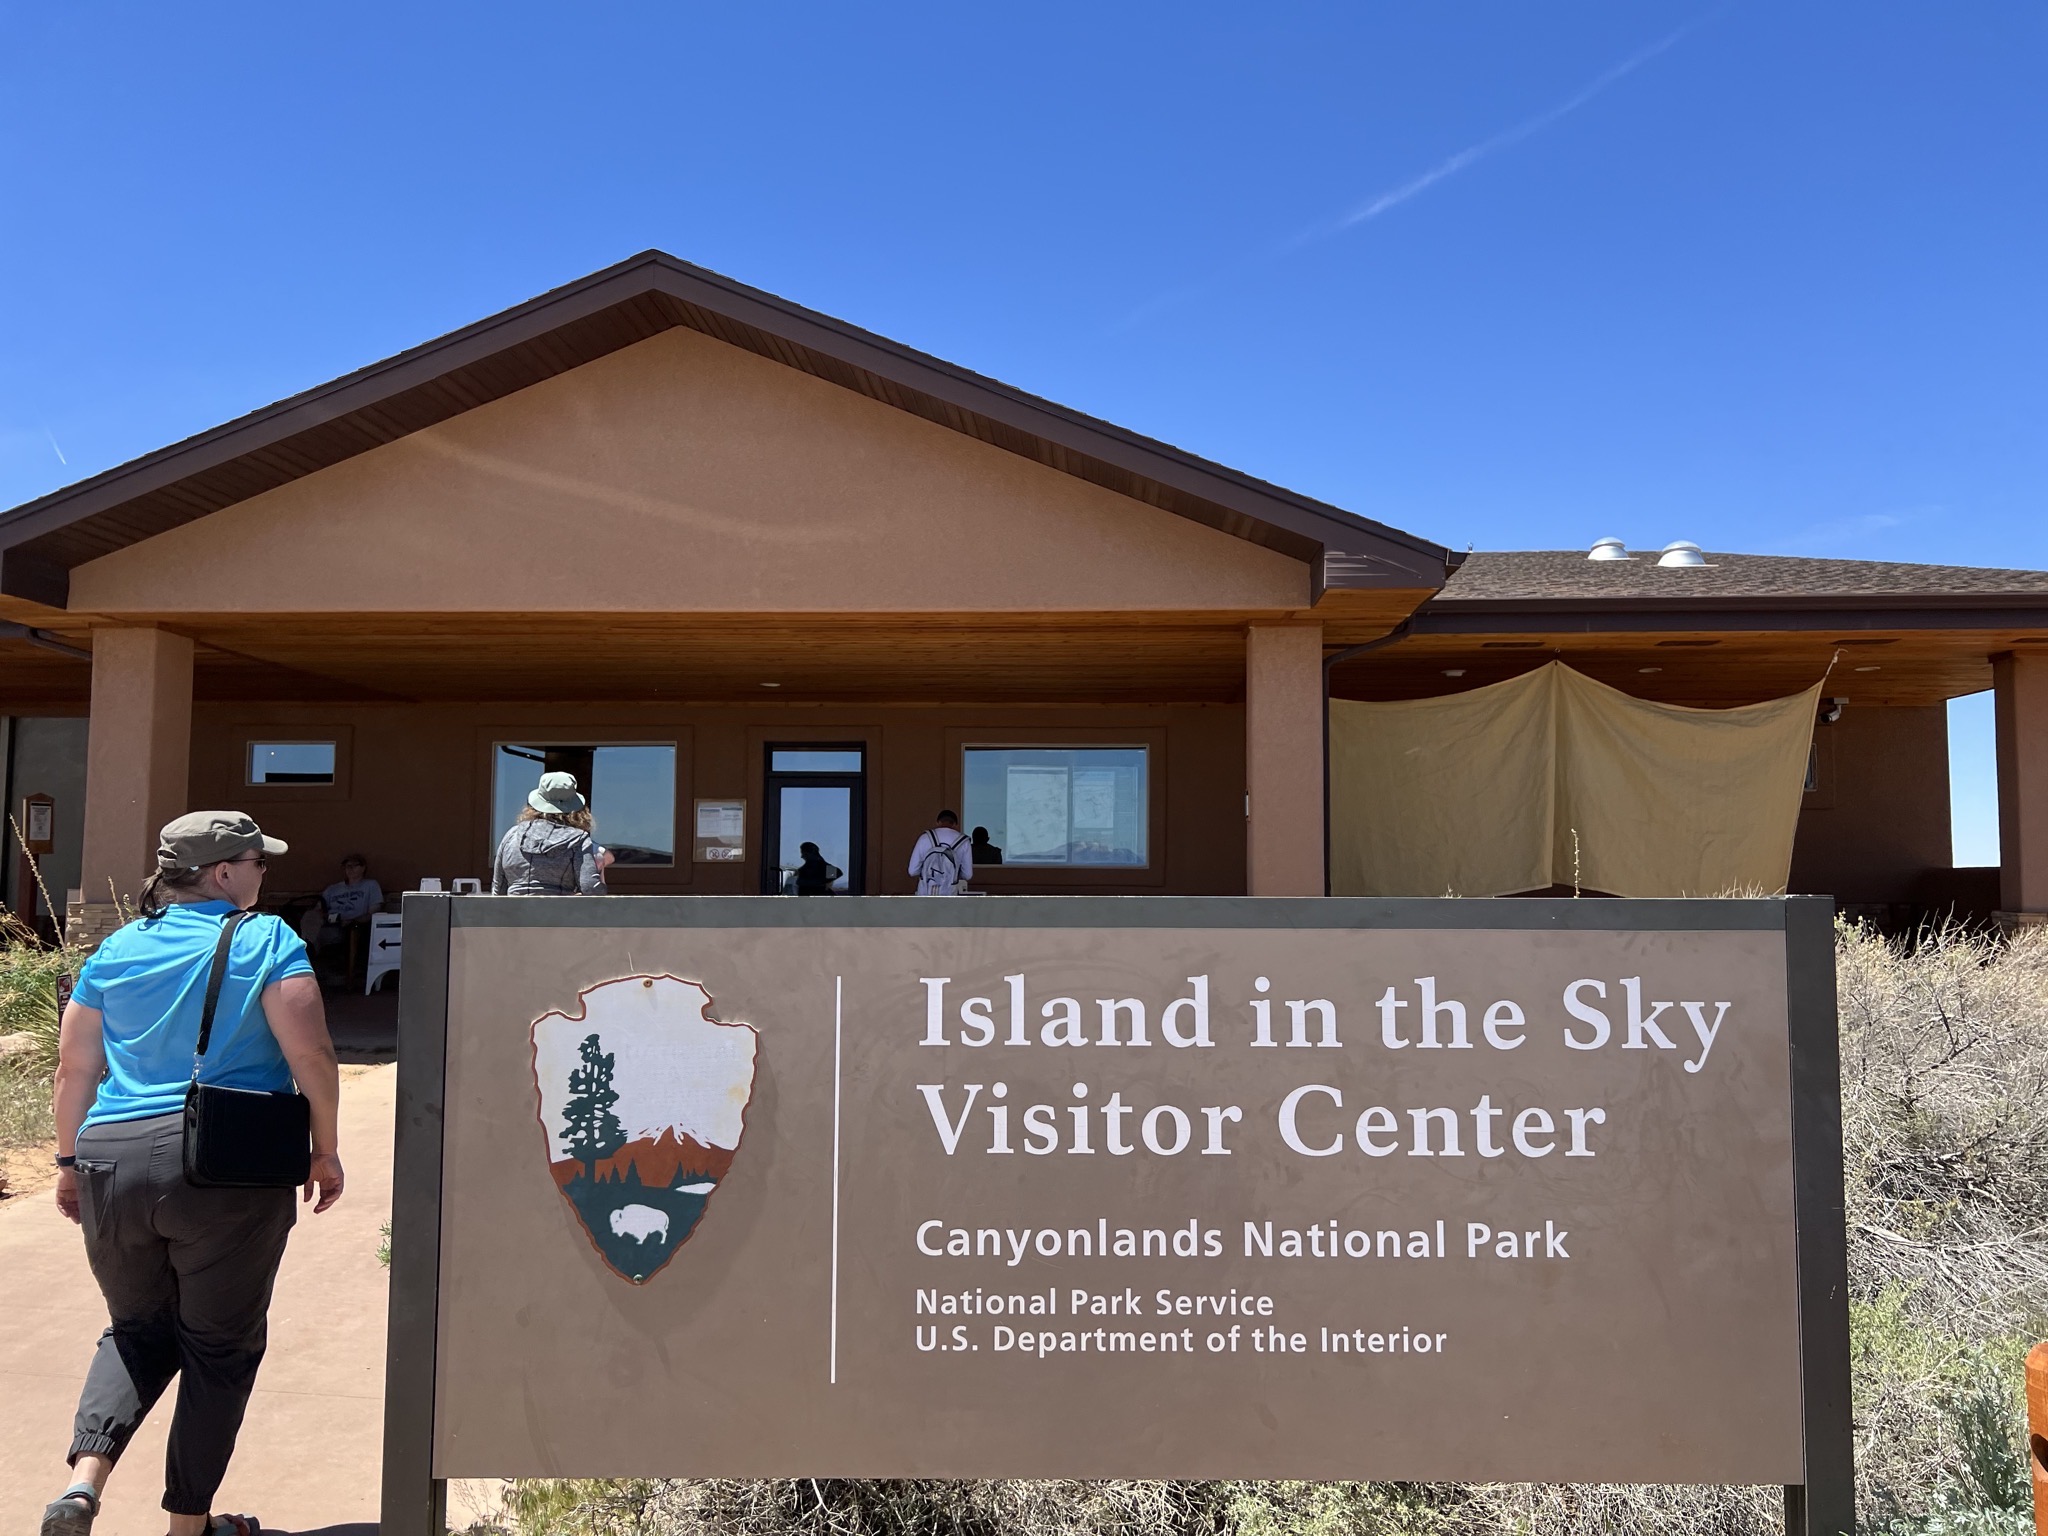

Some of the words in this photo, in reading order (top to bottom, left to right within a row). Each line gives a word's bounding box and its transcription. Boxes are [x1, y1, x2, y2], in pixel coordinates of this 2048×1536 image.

[918, 973, 1216, 1048] Island
[1249, 976, 1343, 1048] in
[1375, 975, 1527, 1050] the
[1562, 975, 1732, 1074] Sky
[916, 1081, 1243, 1156] Visitor
[1278, 1084, 1606, 1158] Center
[916, 1218, 1223, 1267] Canyonlands
[1244, 1219, 1445, 1258] National
[1467, 1220, 1571, 1259] Park
[916, 1287, 1056, 1315] National
[1071, 1288, 1143, 1315] Park
[1156, 1288, 1274, 1316] Service
[915, 1325, 978, 1352] U.S.
[994, 1325, 1194, 1359] Department
[1206, 1324, 1241, 1353] of
[1251, 1325, 1307, 1353] the
[1321, 1325, 1447, 1353] Interior
